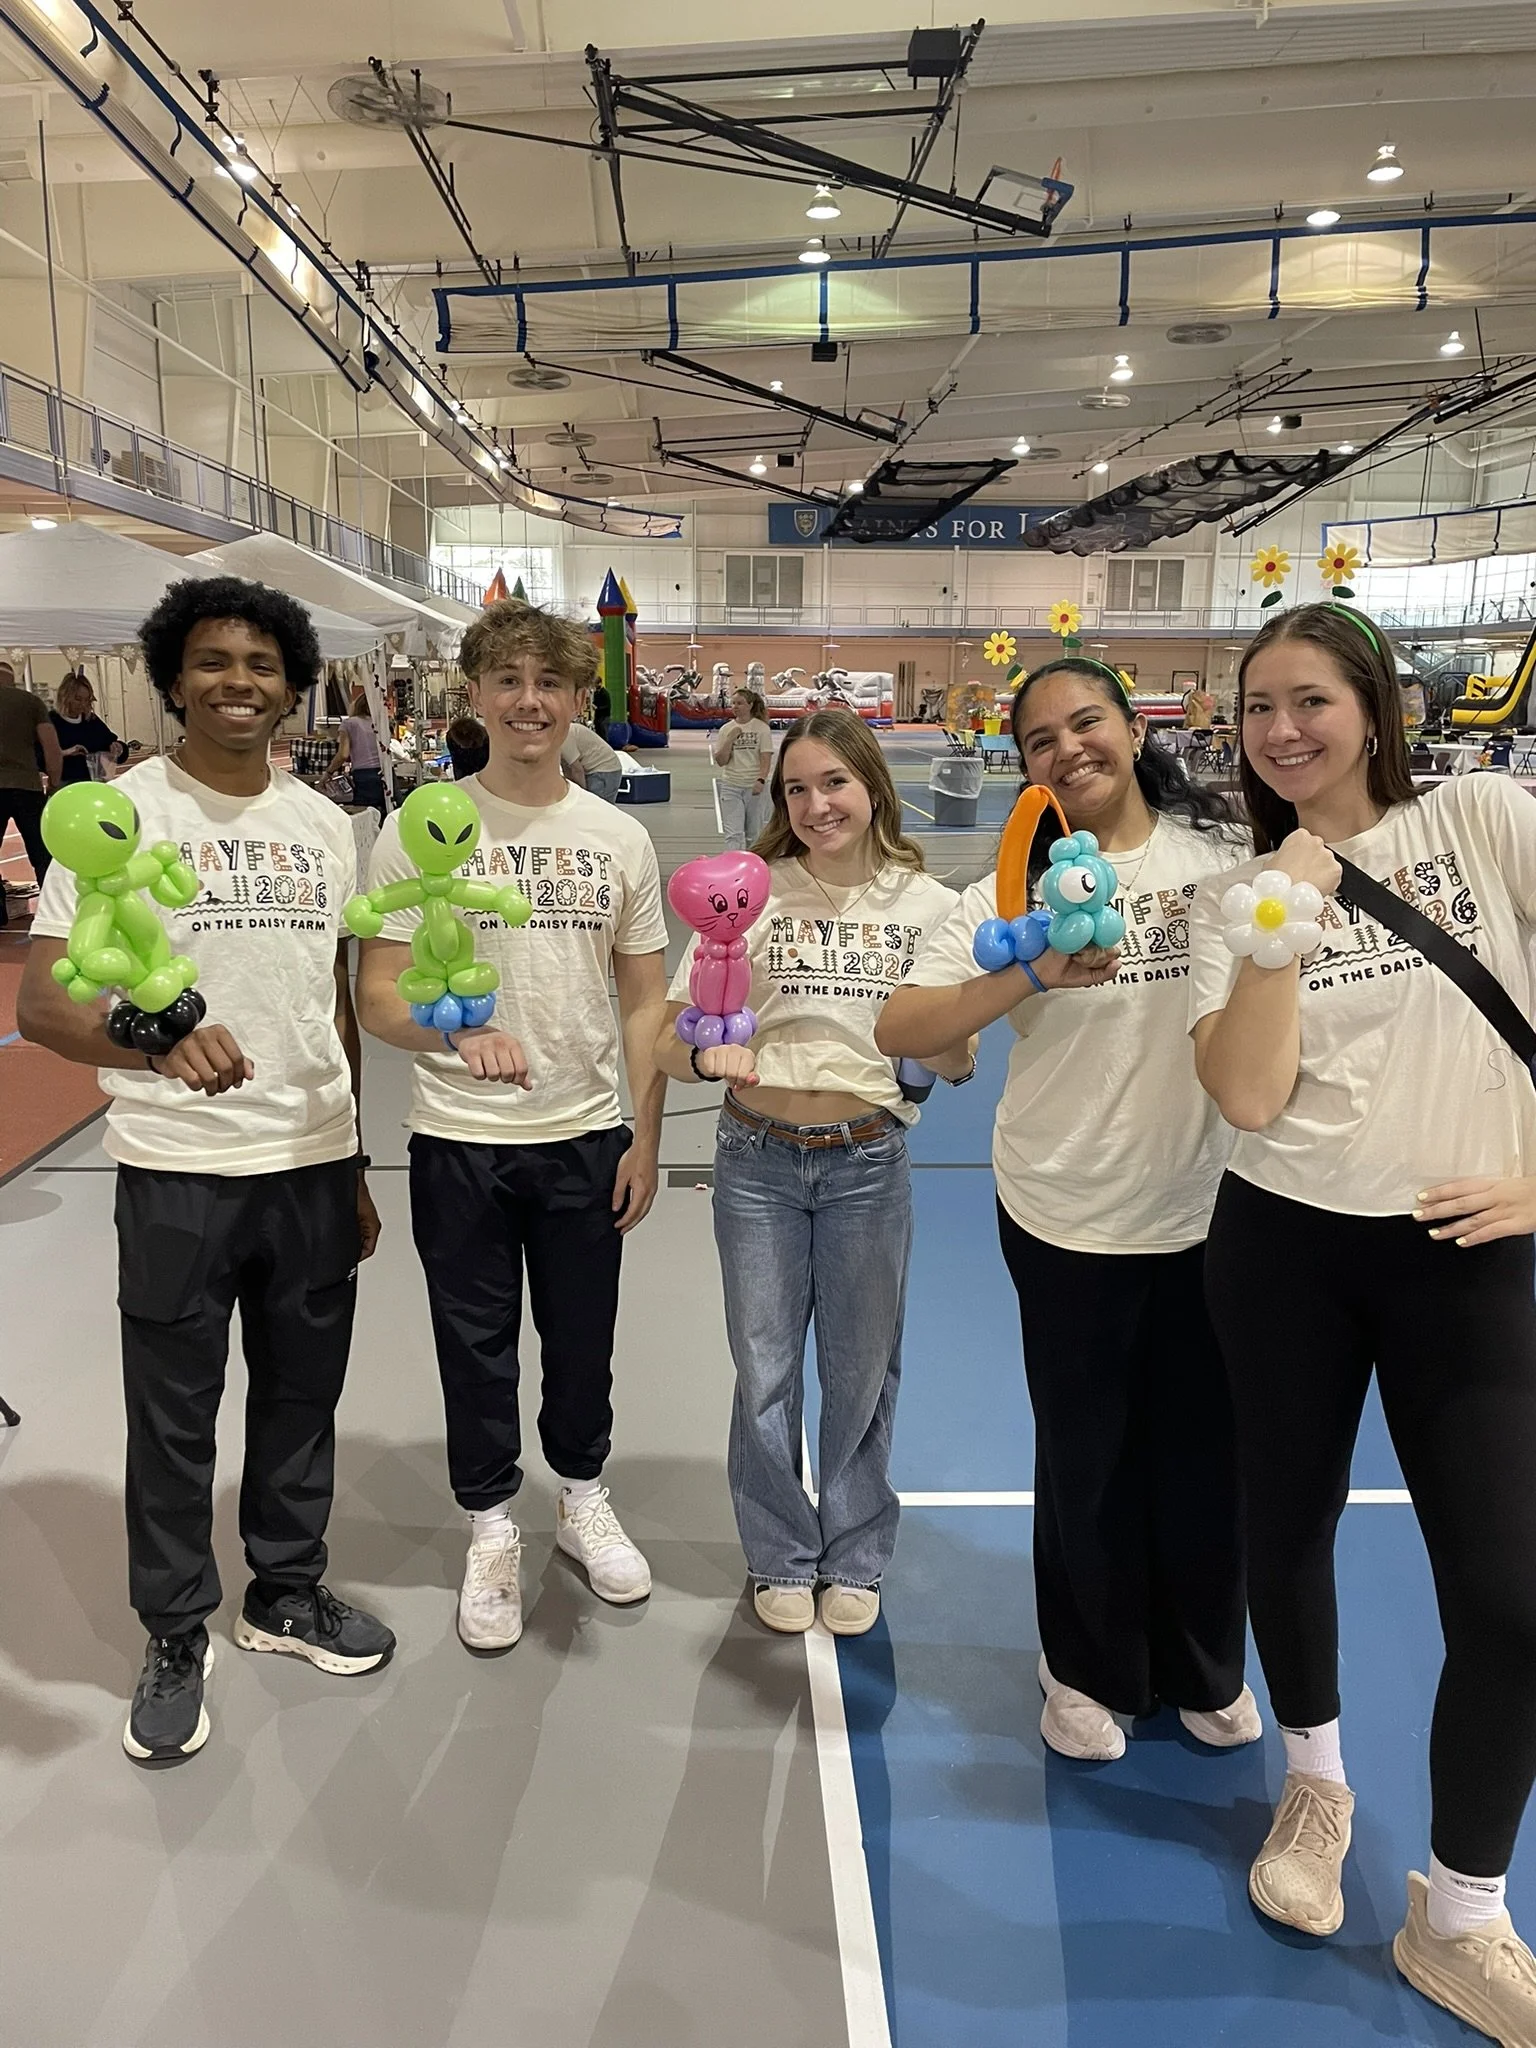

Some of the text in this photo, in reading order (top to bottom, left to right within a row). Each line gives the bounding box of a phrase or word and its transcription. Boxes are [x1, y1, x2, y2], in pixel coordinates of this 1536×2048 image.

[951, 520, 1005, 538] FOR
[461, 846, 612, 880] MAYFEST
[254, 875, 327, 909] 2026
[537, 879, 611, 910] 2026
[192, 918, 326, 932] ON THE DAISY FARM
[479, 920, 498, 930] ON
[530, 920, 568, 929] DAISY
[572, 920, 603, 931] FARM
[770, 916, 922, 954] MAYFEST
[1144, 964, 1190, 982] DAISY
[1308, 976, 1334, 992] ON
[1339, 967, 1375, 984] THE
[781, 985, 800, 995] ON
[804, 985, 829, 995] THE
[833, 986, 873, 999] DAISY
